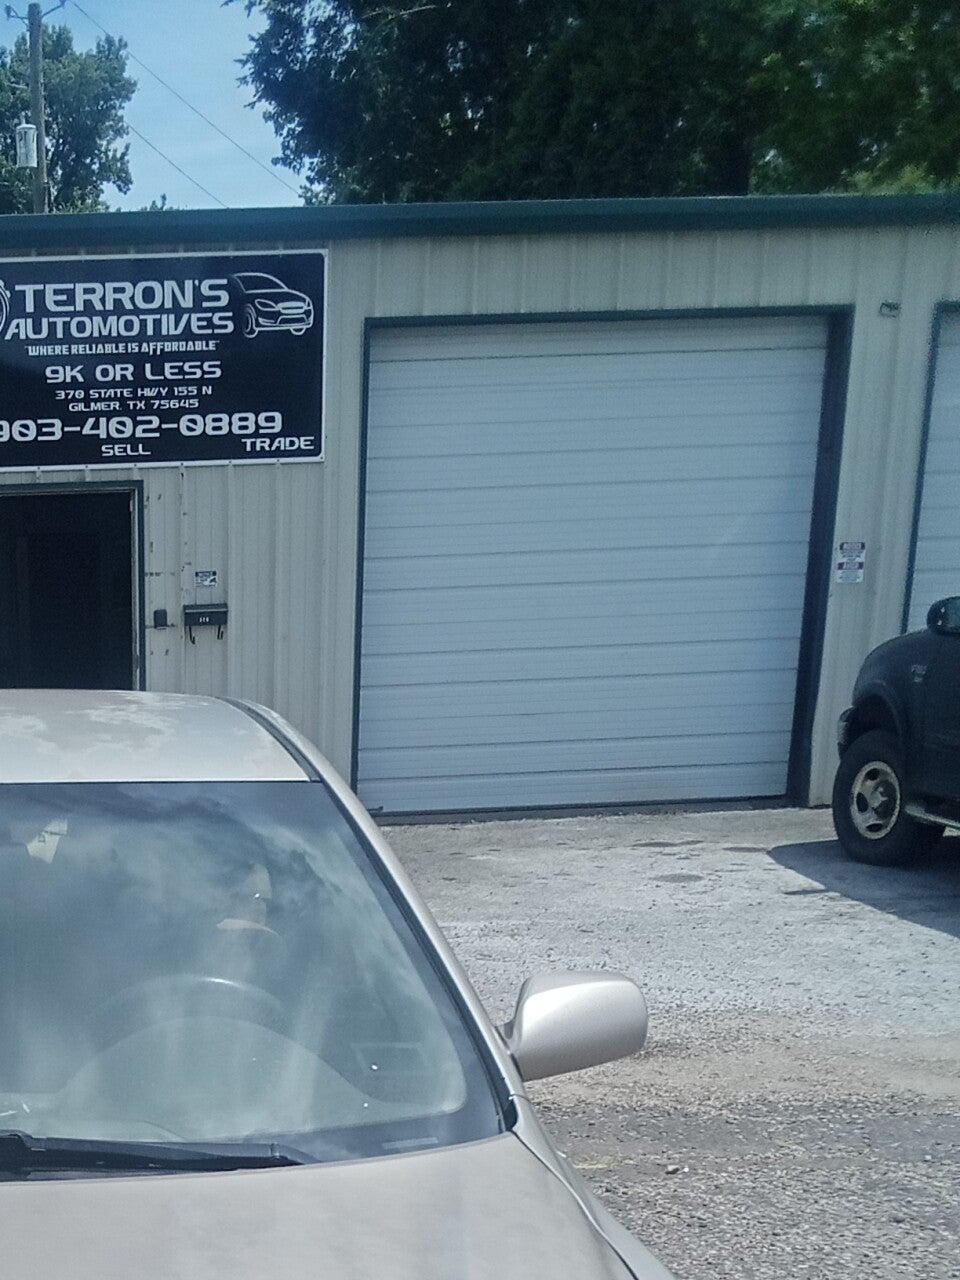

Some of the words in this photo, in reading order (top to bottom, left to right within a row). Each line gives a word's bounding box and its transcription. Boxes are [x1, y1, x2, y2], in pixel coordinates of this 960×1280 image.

[14, 278, 230, 313] TERRON'S
[4, 311, 235, 341] AUTOMOTIVES
[70, 342, 126, 355] RELIABLE
[127, 342, 139, 354] IS
[45, 365, 85, 384] 9K
[95, 363, 135, 382] OR
[144, 360, 222, 381] LESS
[55, 389, 85, 400] 370
[89, 388, 133, 399] STATE
[137, 386, 169, 398] HWY
[173, 385, 198, 396] 155
[201, 385, 213, 396] N
[126, 400, 146, 411] TX
[150, 398, 200, 410] 75645
[101, 444, 152, 457] SELL
[240, 436, 315, 452] TRADE
